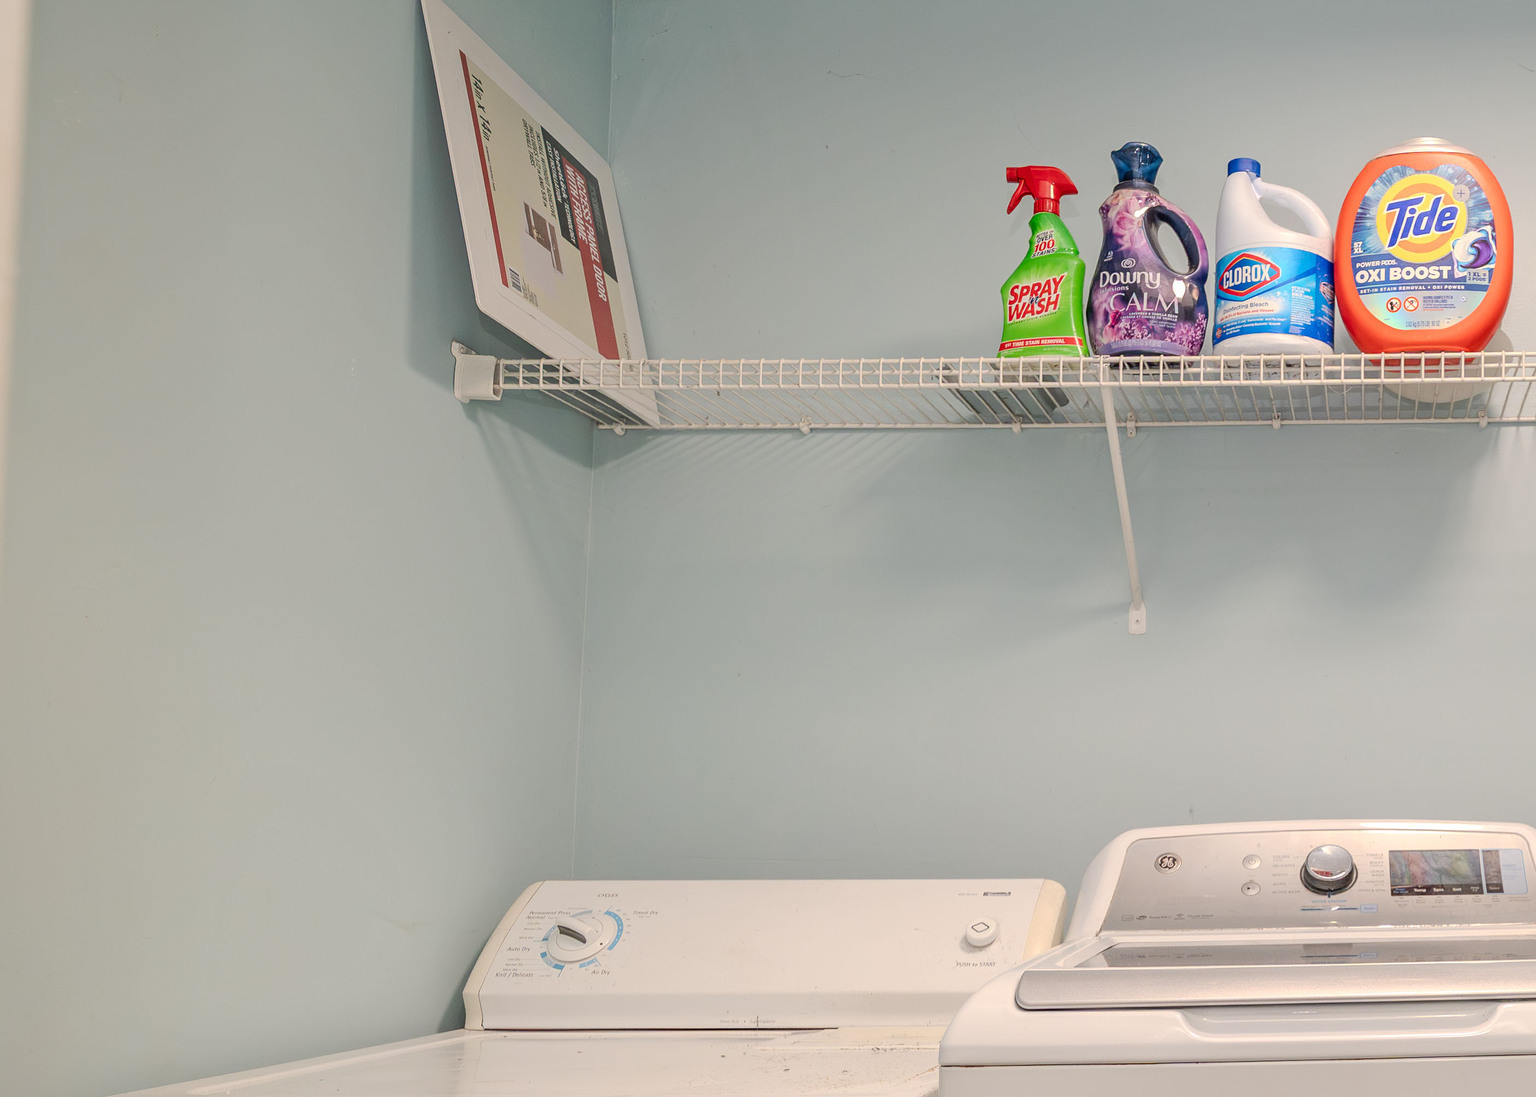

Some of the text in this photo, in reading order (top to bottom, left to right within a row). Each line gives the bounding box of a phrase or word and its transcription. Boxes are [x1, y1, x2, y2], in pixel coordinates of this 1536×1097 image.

[564, 161, 588, 245] WITH FRAME
[574, 170, 592, 226] ACCESS
[1386, 196, 1458, 248] Tide
[584, 220, 600, 267] PANEL
[1035, 239, 1055, 252] 100
[1037, 234, 1053, 244] OVER
[1223, 264, 1271, 289] CLOROX
[1356, 260, 1380, 268] POWER
[1356, 266, 1451, 283] OXI BOOST
[591, 262, 607, 303] DOOR
[1009, 274, 1066, 305] SPRAY
[1100, 271, 1160, 289] Downy
[1008, 294, 1059, 322] WASH
[1110, 292, 1178, 314] CALM
[1223, 302, 1248, 314] Disinfecting
